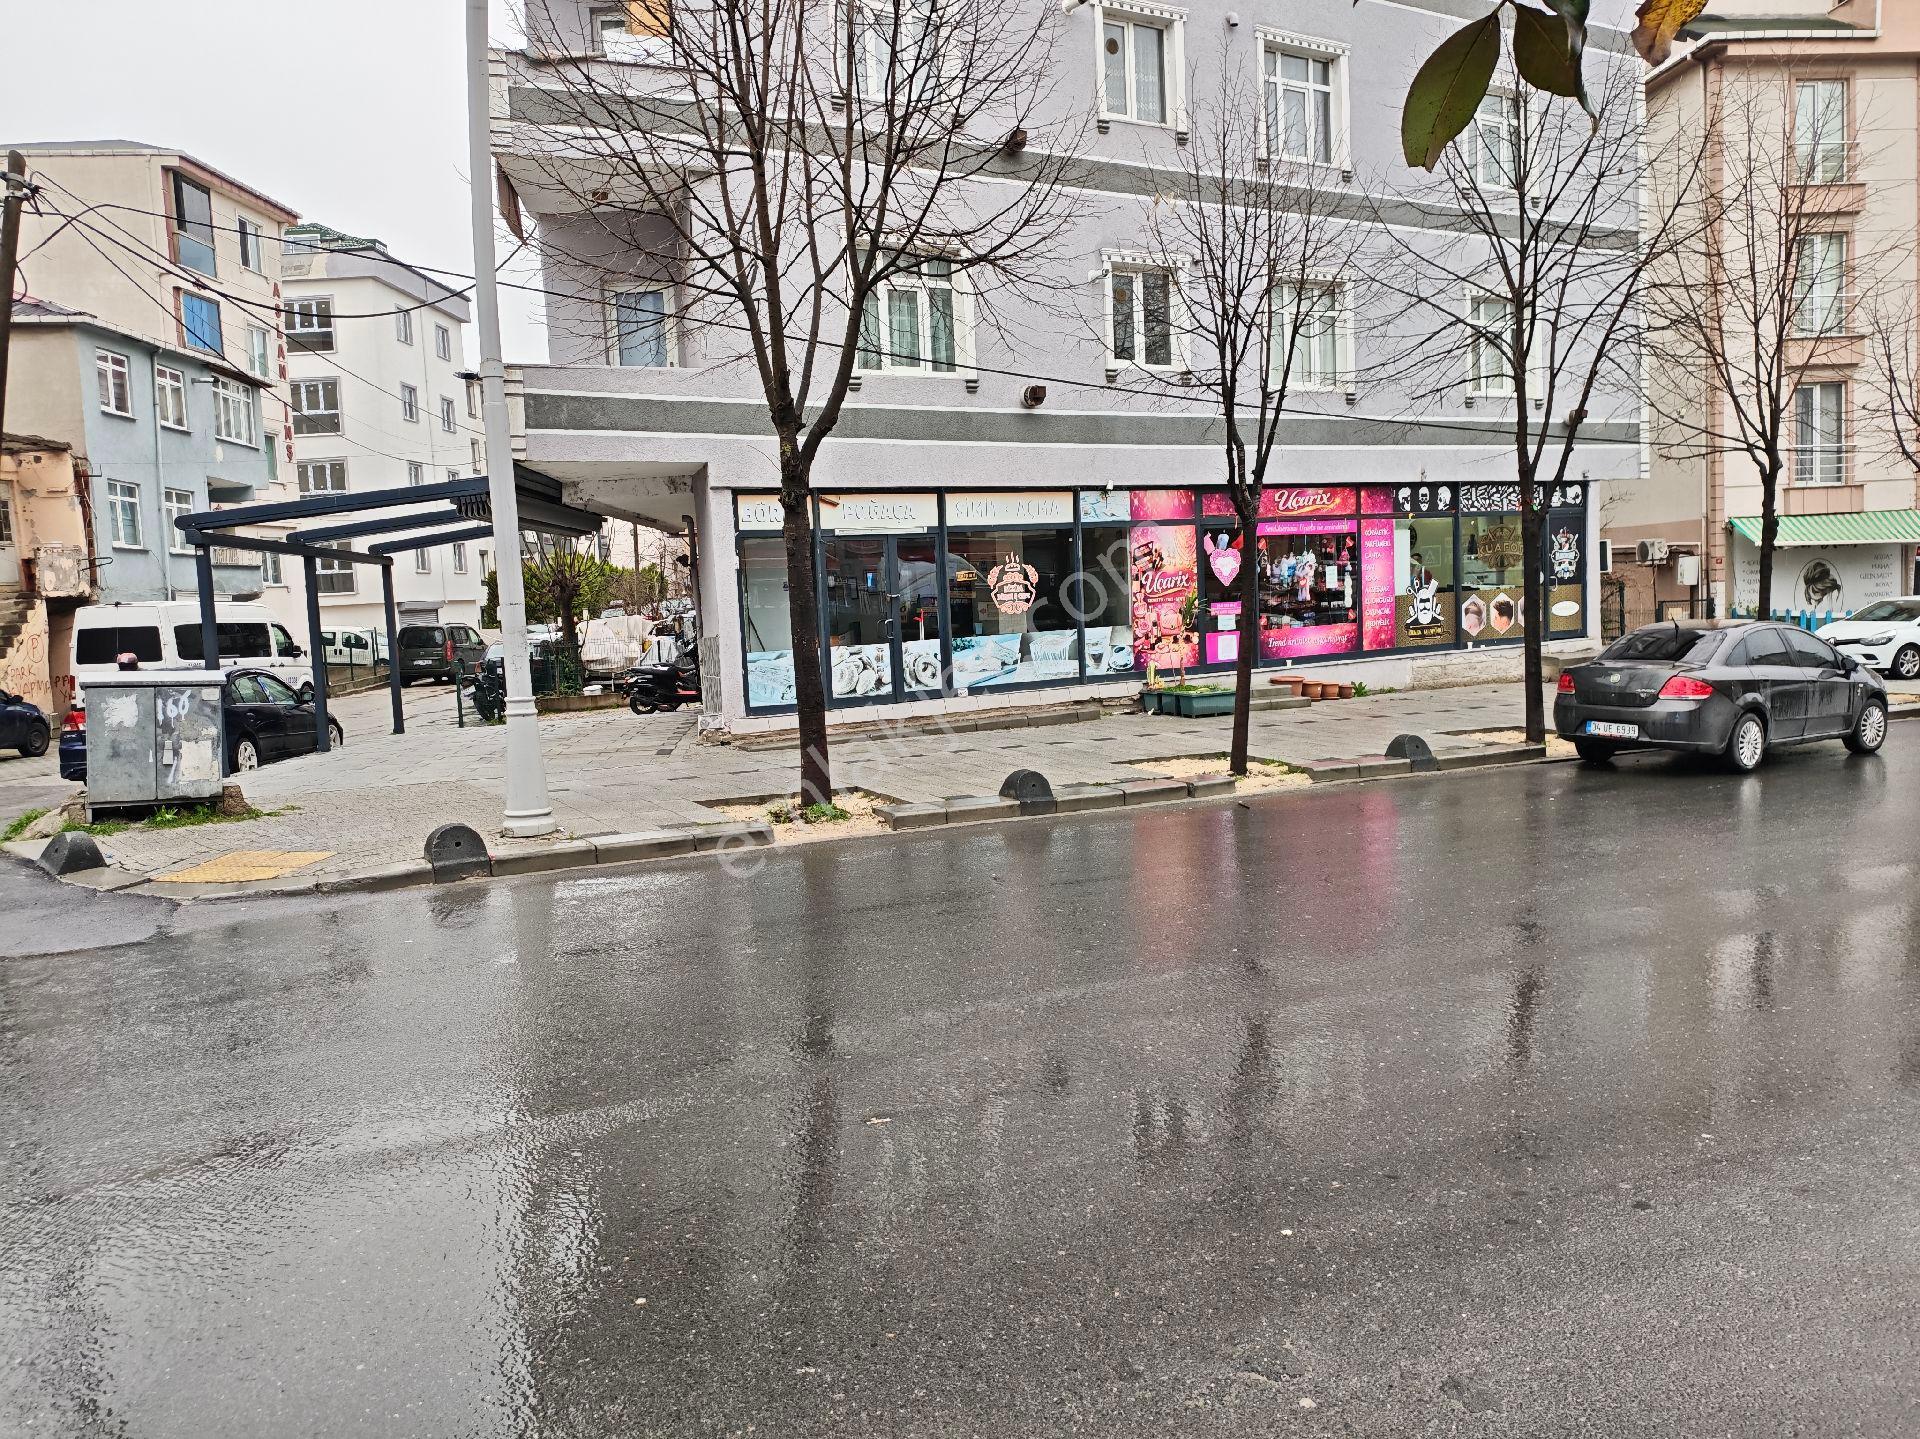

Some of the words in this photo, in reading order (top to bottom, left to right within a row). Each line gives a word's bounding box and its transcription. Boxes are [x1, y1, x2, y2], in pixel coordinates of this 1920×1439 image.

[271, 282, 287, 381] ASLAN
[842, 498, 917, 525] POĞAÇA
[1142, 570, 1191, 594] Uçarix
[1592, 722, 1601, 732] 34
